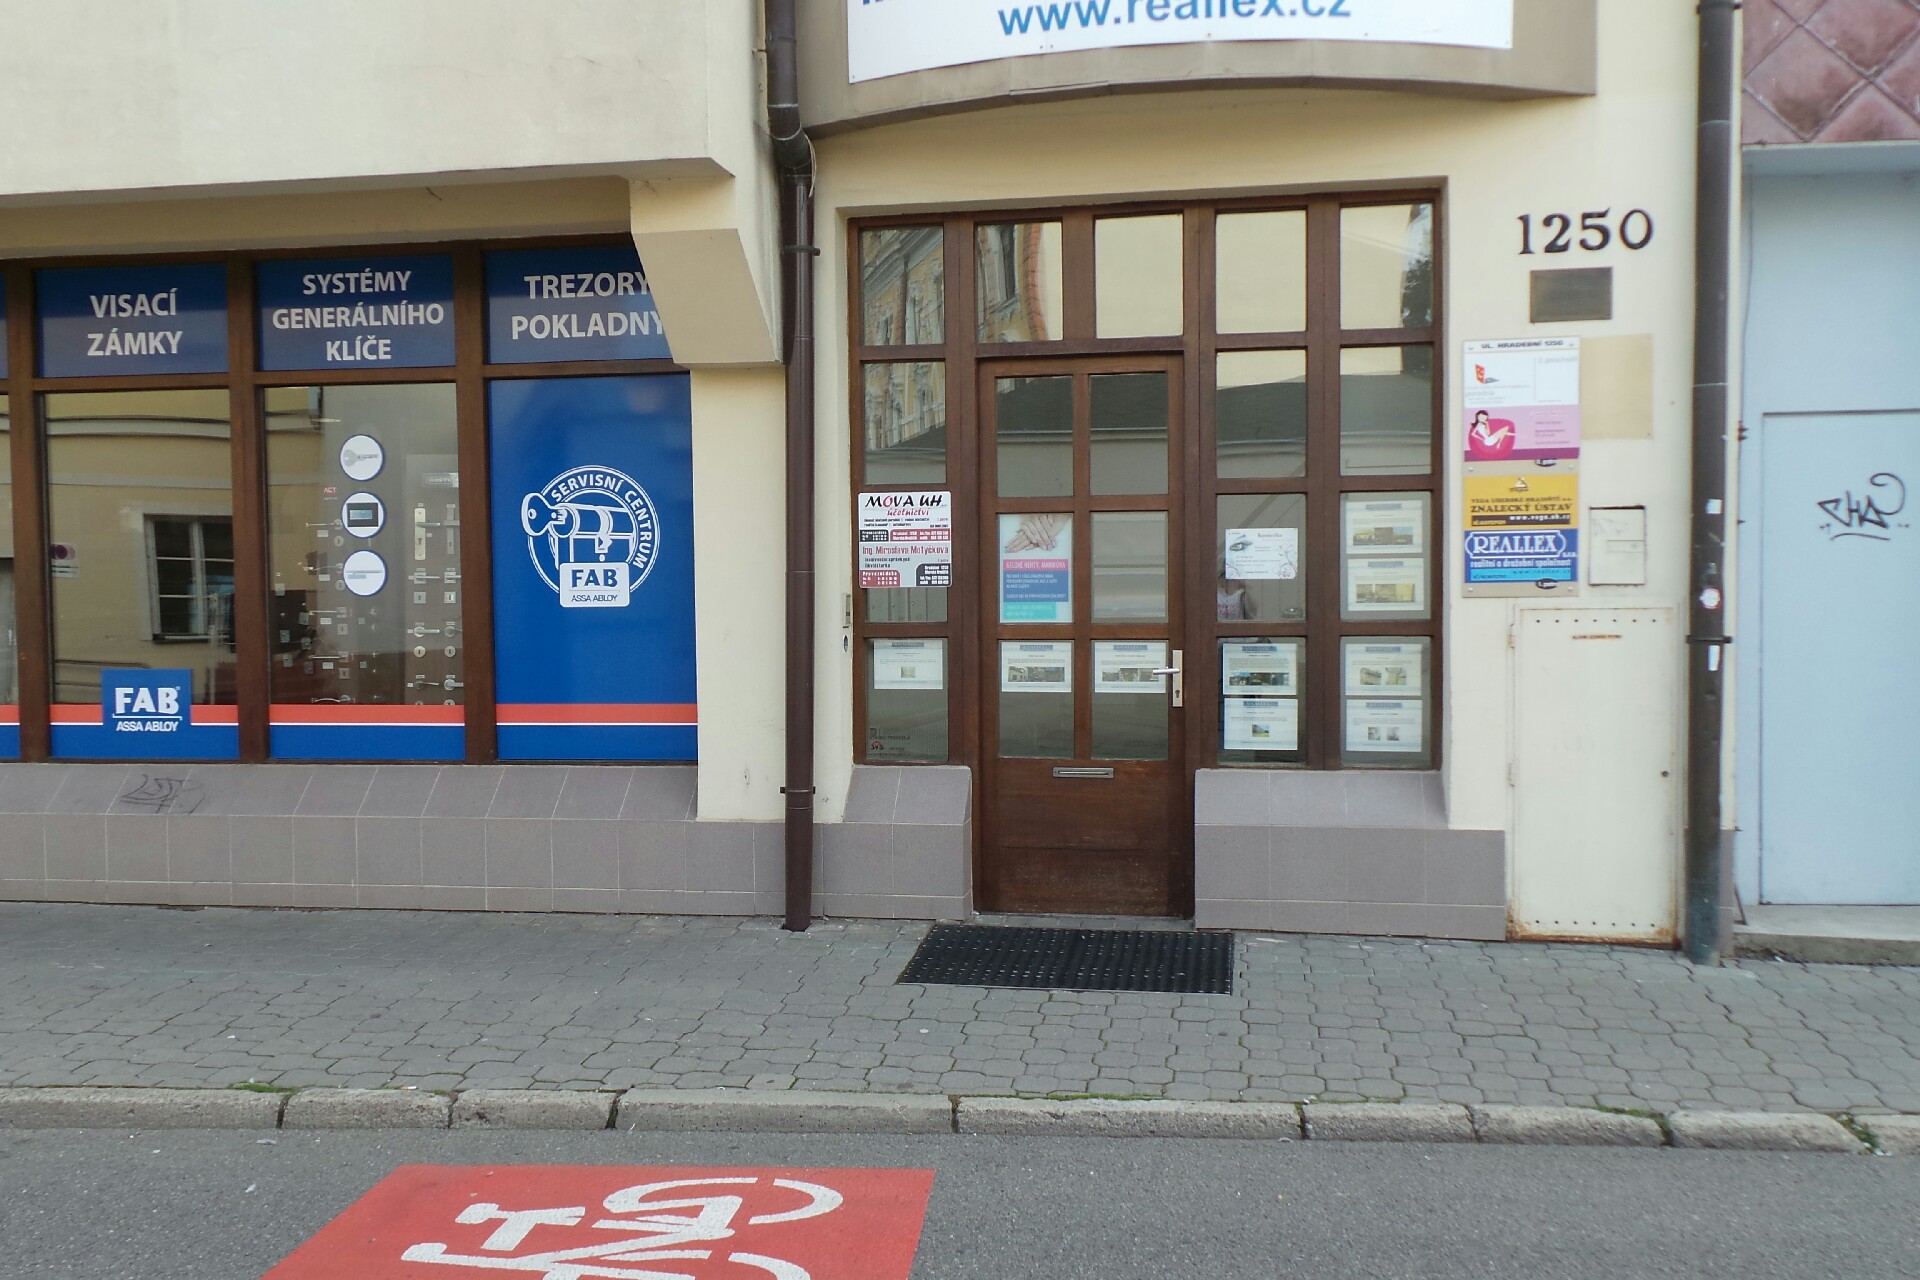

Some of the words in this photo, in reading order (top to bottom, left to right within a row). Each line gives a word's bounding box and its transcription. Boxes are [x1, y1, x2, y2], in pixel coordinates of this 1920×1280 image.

[1517, 208, 1653, 254] 1250
[302, 268, 412, 295] SYSTÉMY
[524, 272, 649, 299] TREZORY
[90, 288, 178, 318] VISACÍ
[272, 300, 444, 329] GENERÁLNÍHO
[511, 311, 664, 340] POKLADNY
[87, 328, 183, 356] ZÁMKY
[326, 335, 392, 361] KLÍČE
[865, 495, 914, 508] MOVA
[920, 494, 942, 507] UH
[1471, 503, 1531, 513] ZNALECKÝ
[1535, 502, 1572, 511] ÚSTAV
[551, 474, 624, 502] SERVISNÍ
[624, 490, 652, 569] CENTRUM
[876, 546, 909, 554] Miroslava
[1472, 535, 1557, 554] REALLEX
[571, 569, 618, 588] FAB
[115, 687, 179, 714] FAB
[116, 721, 143, 731] ASSA
[144, 721, 179, 731] ABLOY
